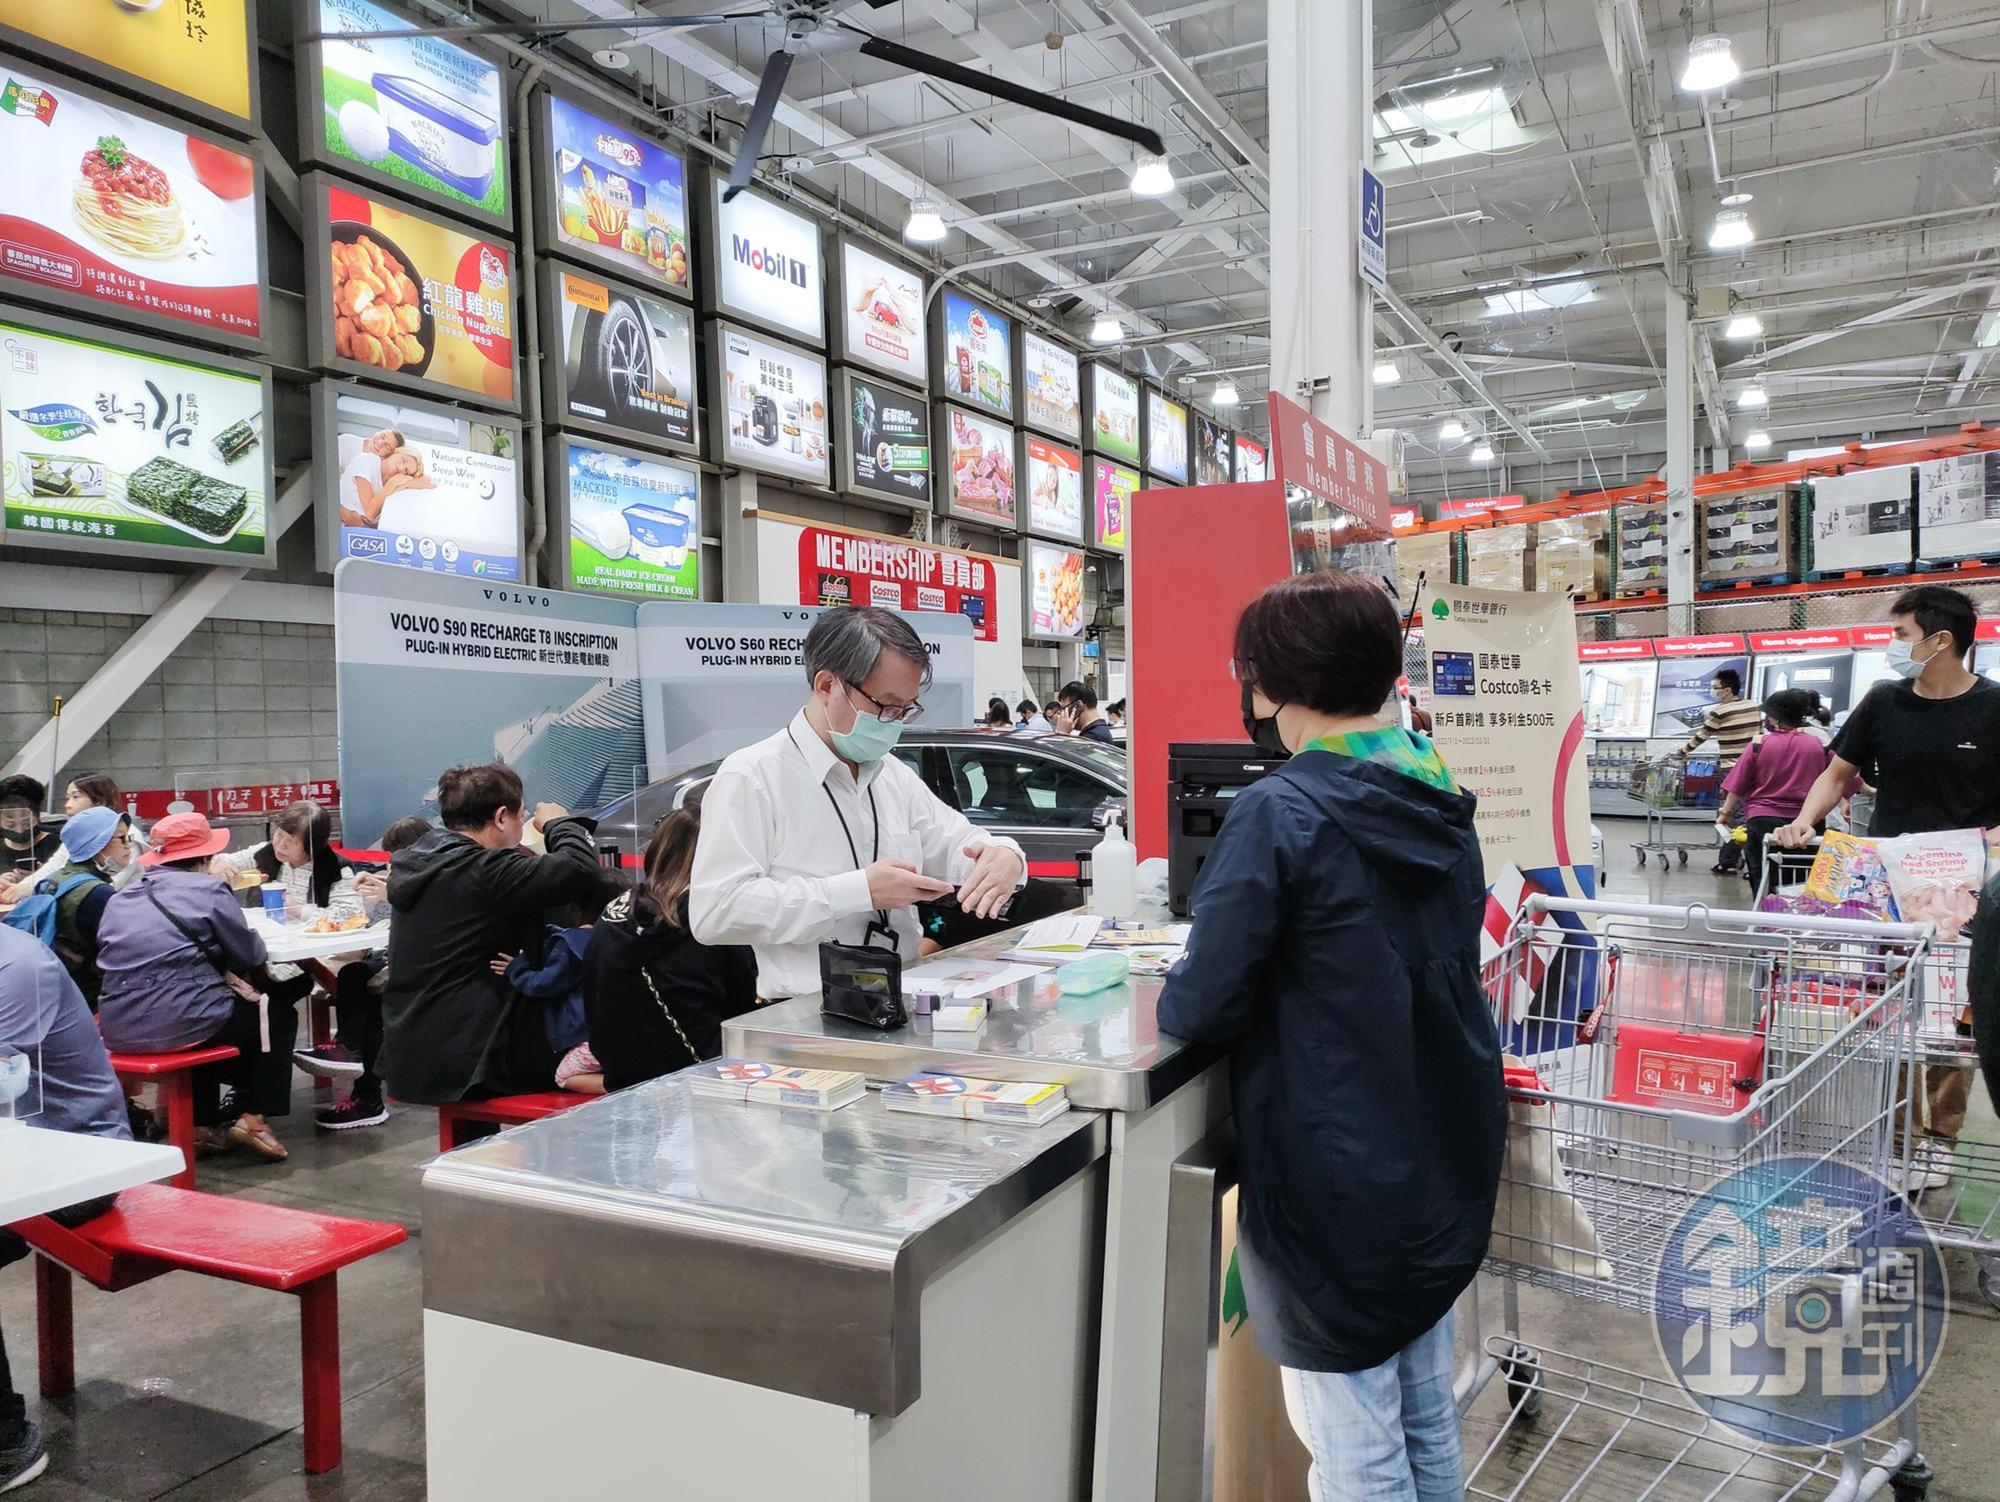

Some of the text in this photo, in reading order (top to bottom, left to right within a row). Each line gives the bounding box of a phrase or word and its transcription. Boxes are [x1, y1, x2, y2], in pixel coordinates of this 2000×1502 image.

[732, 233, 786, 281] Mobil
[422, 277, 505, 324] 紅龍雞塊
[568, 284, 600, 301] Continental
[423, 303, 465, 326] Chicken
[465, 316, 505, 337] Nuggets
[431, 463, 476, 480] Sleep Well
[465, 455, 513, 474] Comfortable
[1306, 462, 1377, 519] Member Service
[1464, 500, 1498, 508] SHARP
[23, 514, 116, 536] 韓國傳統海苔
[350, 537, 385, 554] CASA
[816, 533, 985, 591] MEMBERSHIP 會員部
[594, 565, 676, 584] REAL DAIRY ICE CREAM
[576, 575, 599, 586] MADE
[599, 577, 620, 588] WITH
[620, 579, 644, 590] FRESH
[645, 582, 663, 593] MILK
[670, 585, 695, 596] CREAM
[823, 582, 848, 593] COSTCO
[872, 586, 900, 598] COSTCO
[484, 589, 550, 607] VOLVO
[919, 592, 944, 604] COSTCO
[1453, 600, 1508, 617] 國泰世華銀行
[391, 612, 618, 650] VOLVO S90 RECHARGE T8 INSCRIPTION
[686, 637, 807, 651] VOLVO S60 RECH
[1687, 641, 1734, 650] Organization
[1761, 636, 1839, 646] Home Organization
[405, 638, 450, 655] PLUG-IN
[452, 642, 492, 659] HYBRID
[493, 645, 537, 662] ELECTRIC
[701, 655, 747, 666] PLUG-IN
[750, 655, 792, 666] HYBRID
[1479, 653, 1521, 671] 國泰世華
[1480, 678, 1552, 696] Costco聯名卡
[1435, 711, 1555, 728] 新戶首刷禮 享多利金500元
[226, 789, 252, 801] 刀子
[268, 786, 294, 799] 叉子
[229, 801, 249, 810] Knife
[273, 799, 289, 807] Fork
[1900, 858, 1968, 868] Red Shrimp
[1904, 851, 1964, 861] Argentina
[1909, 866, 1965, 875] Easy Peel
